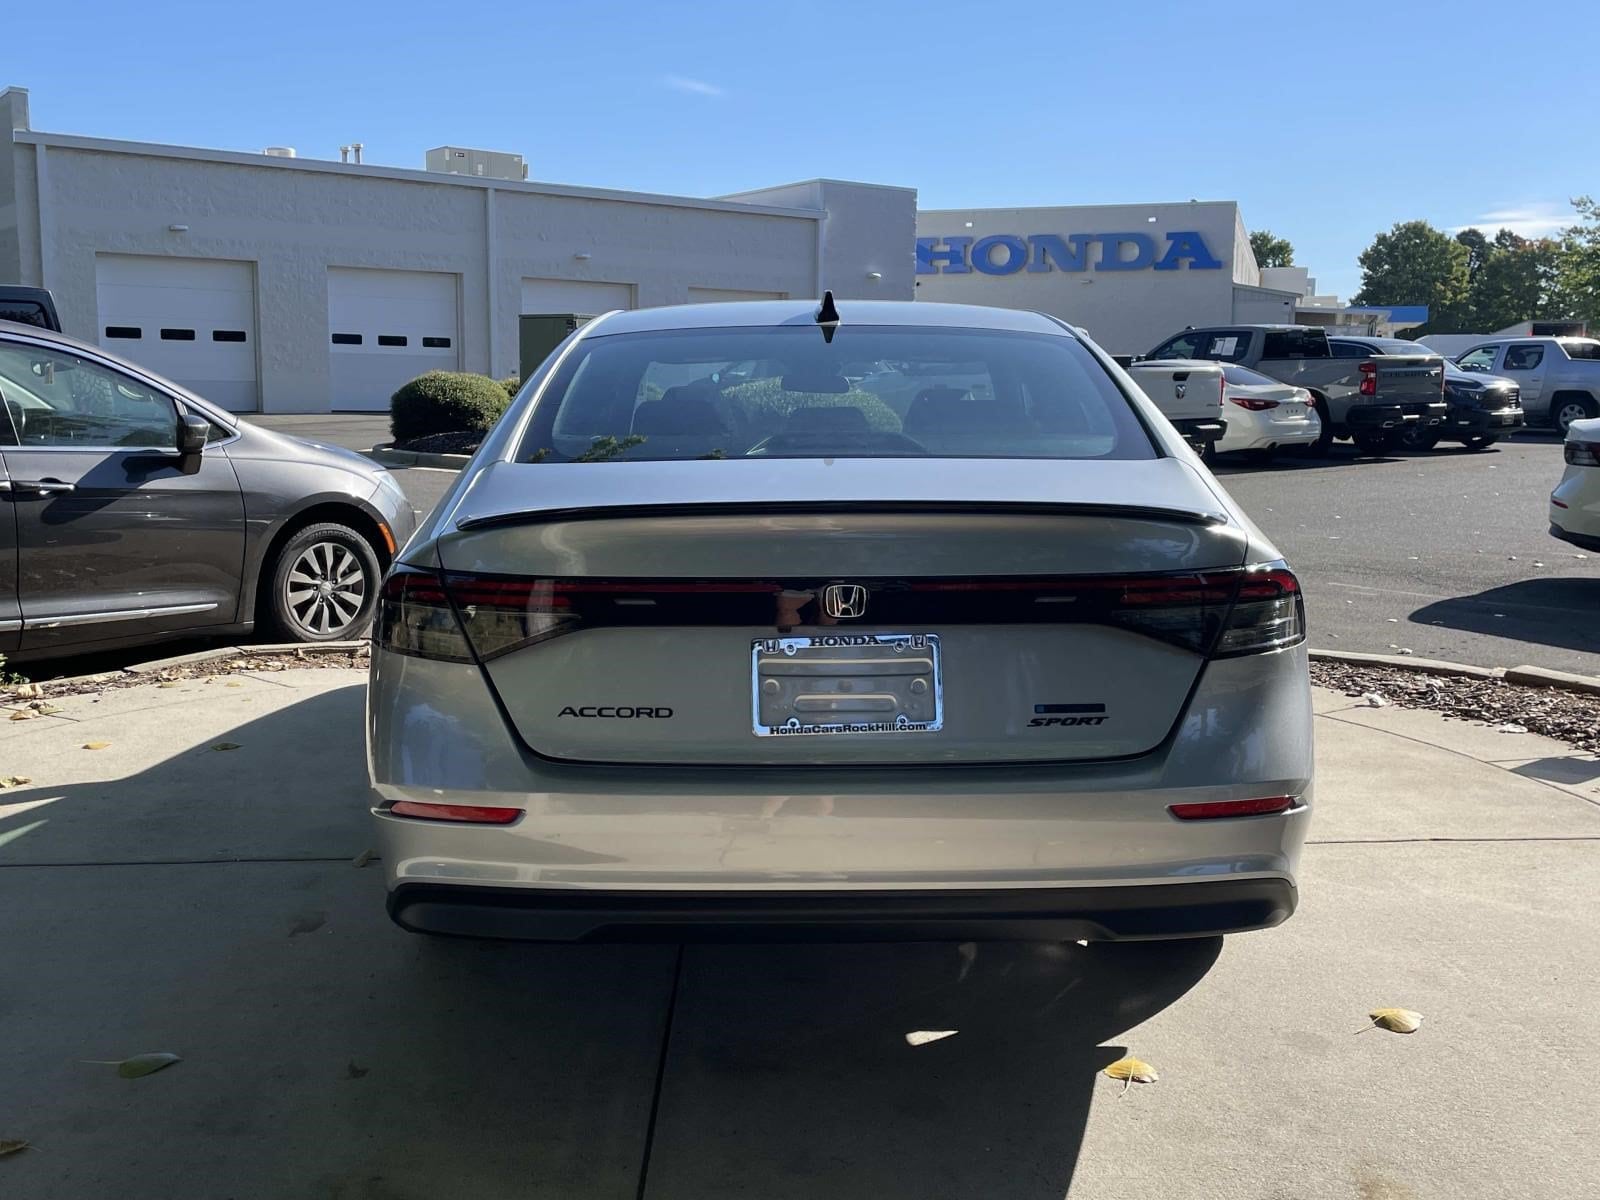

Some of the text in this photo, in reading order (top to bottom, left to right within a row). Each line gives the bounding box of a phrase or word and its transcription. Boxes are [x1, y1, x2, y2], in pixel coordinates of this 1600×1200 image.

[916, 232, 1222, 275] HONDA
[810, 635, 881, 647] HONDA
[557, 706, 674, 719] ACCORD
[1026, 716, 1111, 728] SPORT
[769, 722, 927, 736] HondaCarsRockHill.com
